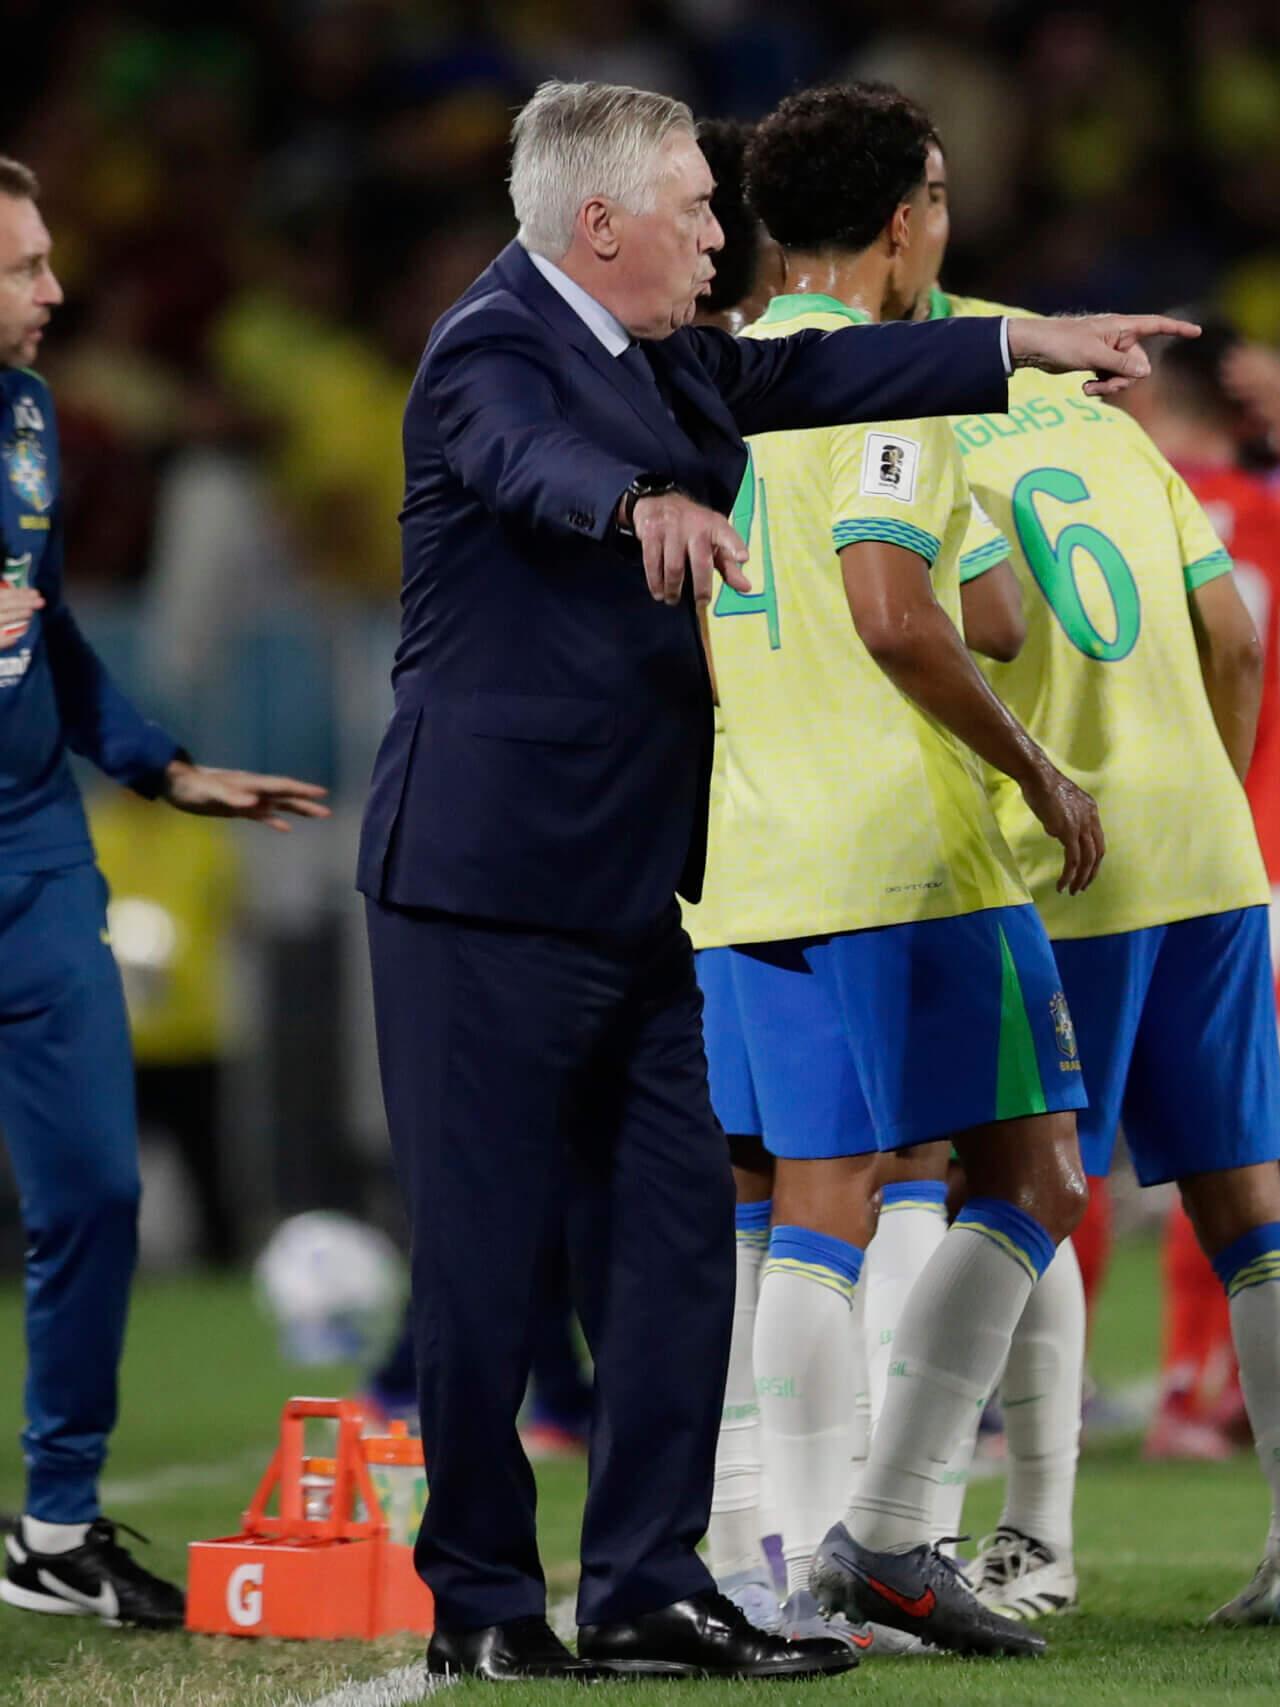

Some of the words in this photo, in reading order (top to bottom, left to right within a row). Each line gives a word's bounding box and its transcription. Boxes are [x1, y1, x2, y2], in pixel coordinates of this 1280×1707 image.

[956, 397, 1065, 456] GLAS
[714, 440, 781, 650] 4
[1012, 467, 1141, 662] 6
[225, 1564, 265, 1627] G
